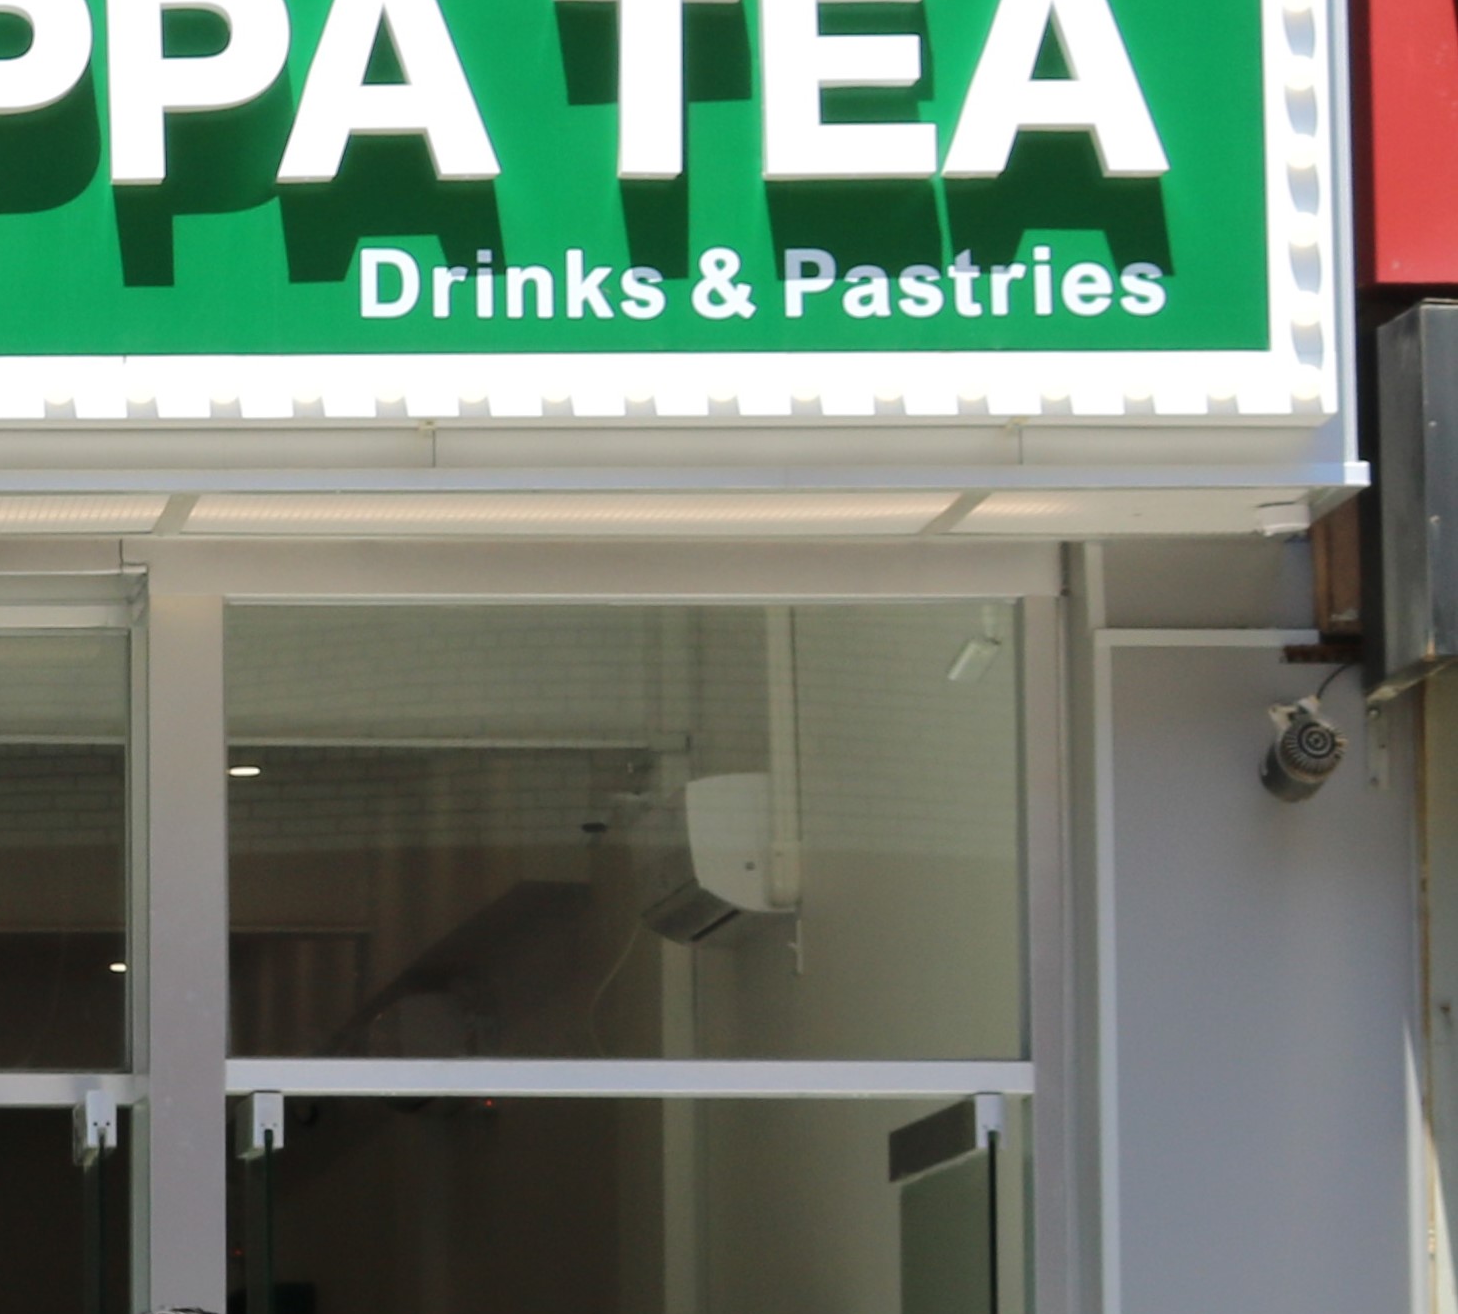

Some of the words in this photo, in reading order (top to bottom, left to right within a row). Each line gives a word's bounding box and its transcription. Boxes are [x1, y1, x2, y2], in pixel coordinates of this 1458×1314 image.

[359, 246, 666, 322] Drinks
[692, 247, 759, 322] &
[783, 243, 1168, 322] Pastries
